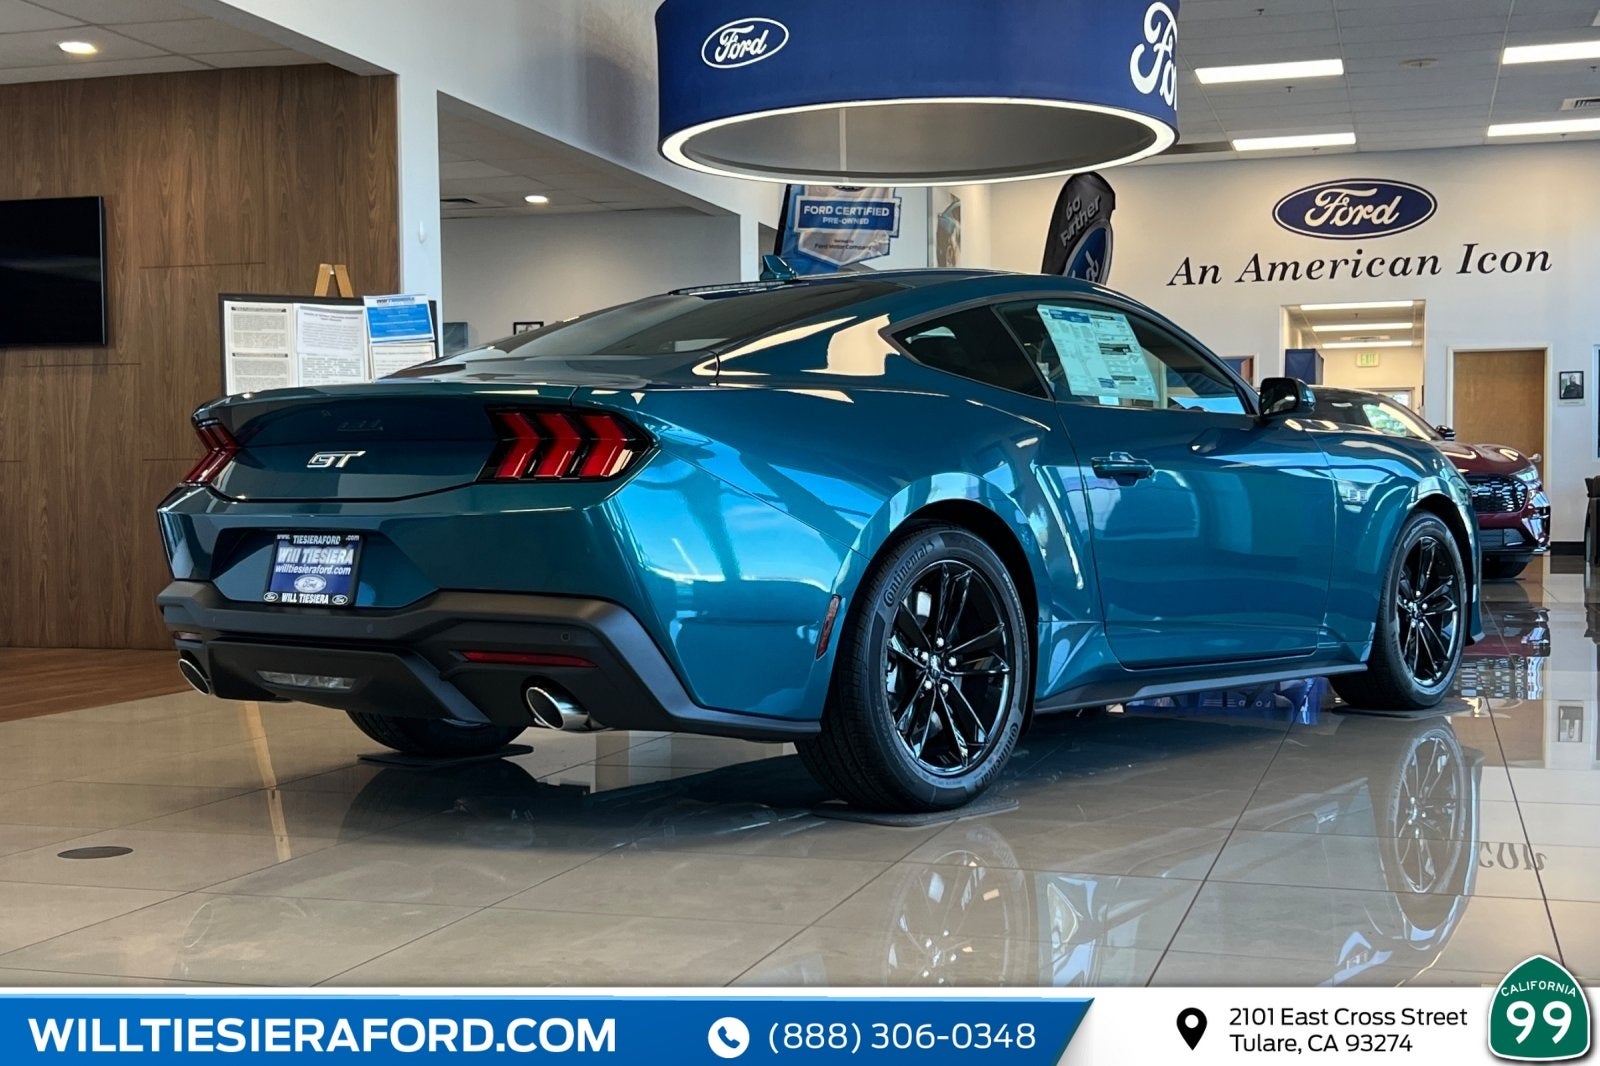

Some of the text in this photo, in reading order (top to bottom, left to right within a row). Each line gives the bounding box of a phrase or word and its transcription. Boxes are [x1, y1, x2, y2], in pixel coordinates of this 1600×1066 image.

[714, 25, 768, 62] Ford
[1129, 1, 1178, 111] Fo
[803, 205, 890, 217] FORD CERTIFIED
[1304, 187, 1402, 227] Ford
[822, 216, 870, 225] PRE-OWNED
[1166, 242, 1553, 287] An American Icon
[306, 450, 366, 468] GT
[293, 534, 341, 545] TIESIERAFORD
[302, 548, 354, 564] TIESIERA
[275, 564, 351, 575] willtiesieraford.com
[883, 543, 929, 607] Continental
[281, 592, 330, 605] WILL TIESIERA
